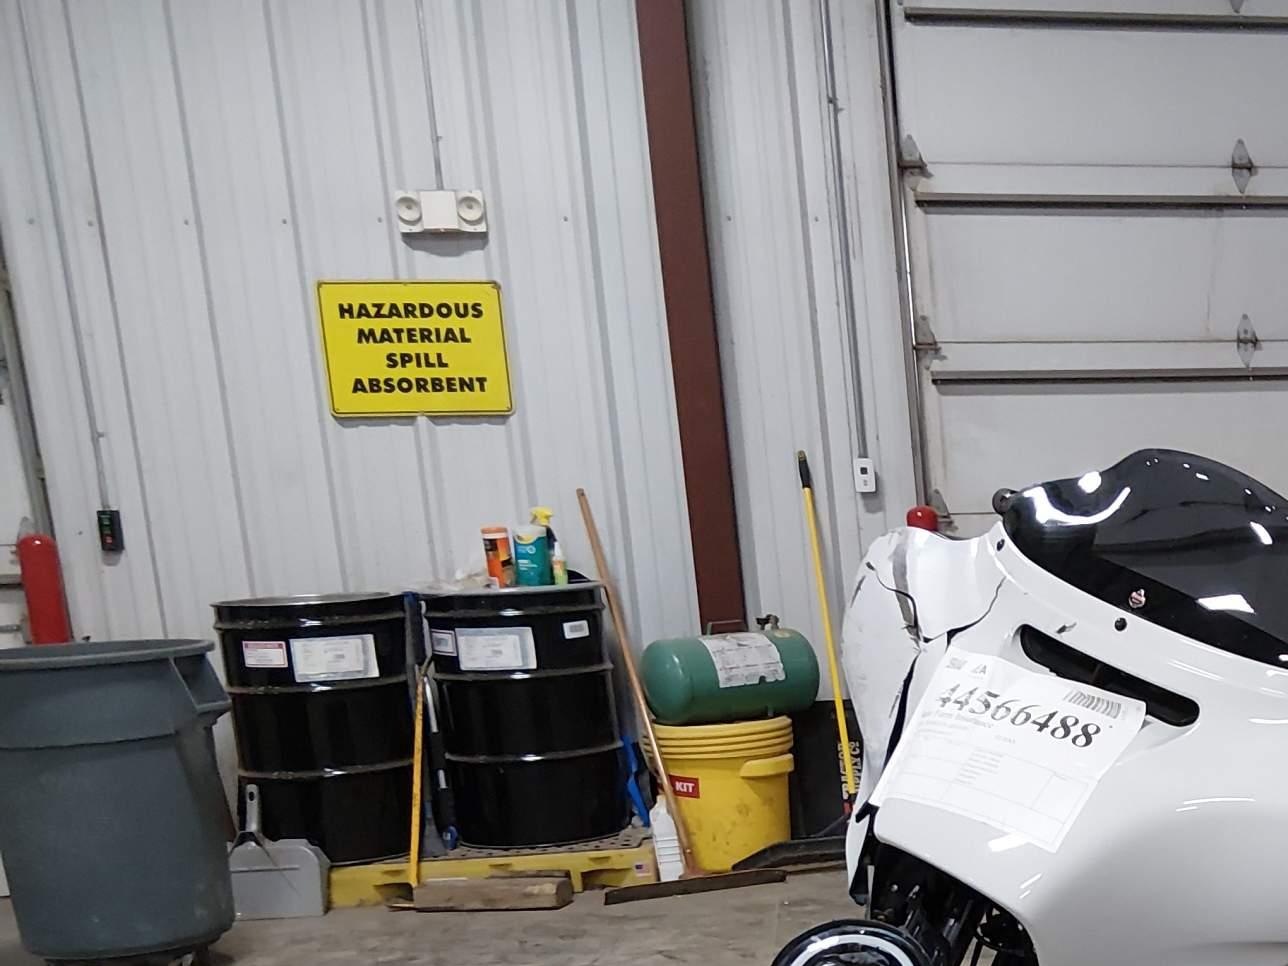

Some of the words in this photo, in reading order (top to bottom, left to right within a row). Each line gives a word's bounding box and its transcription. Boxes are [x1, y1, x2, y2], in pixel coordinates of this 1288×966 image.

[338, 303, 483, 319] HAZARDOUS
[357, 327, 472, 344] MATERIAL
[386, 352, 449, 369] SPILL
[352, 377, 488, 394] ABSORBENT
[938, 683, 1101, 748] 44566488
[674, 780, 696, 793] KIT
